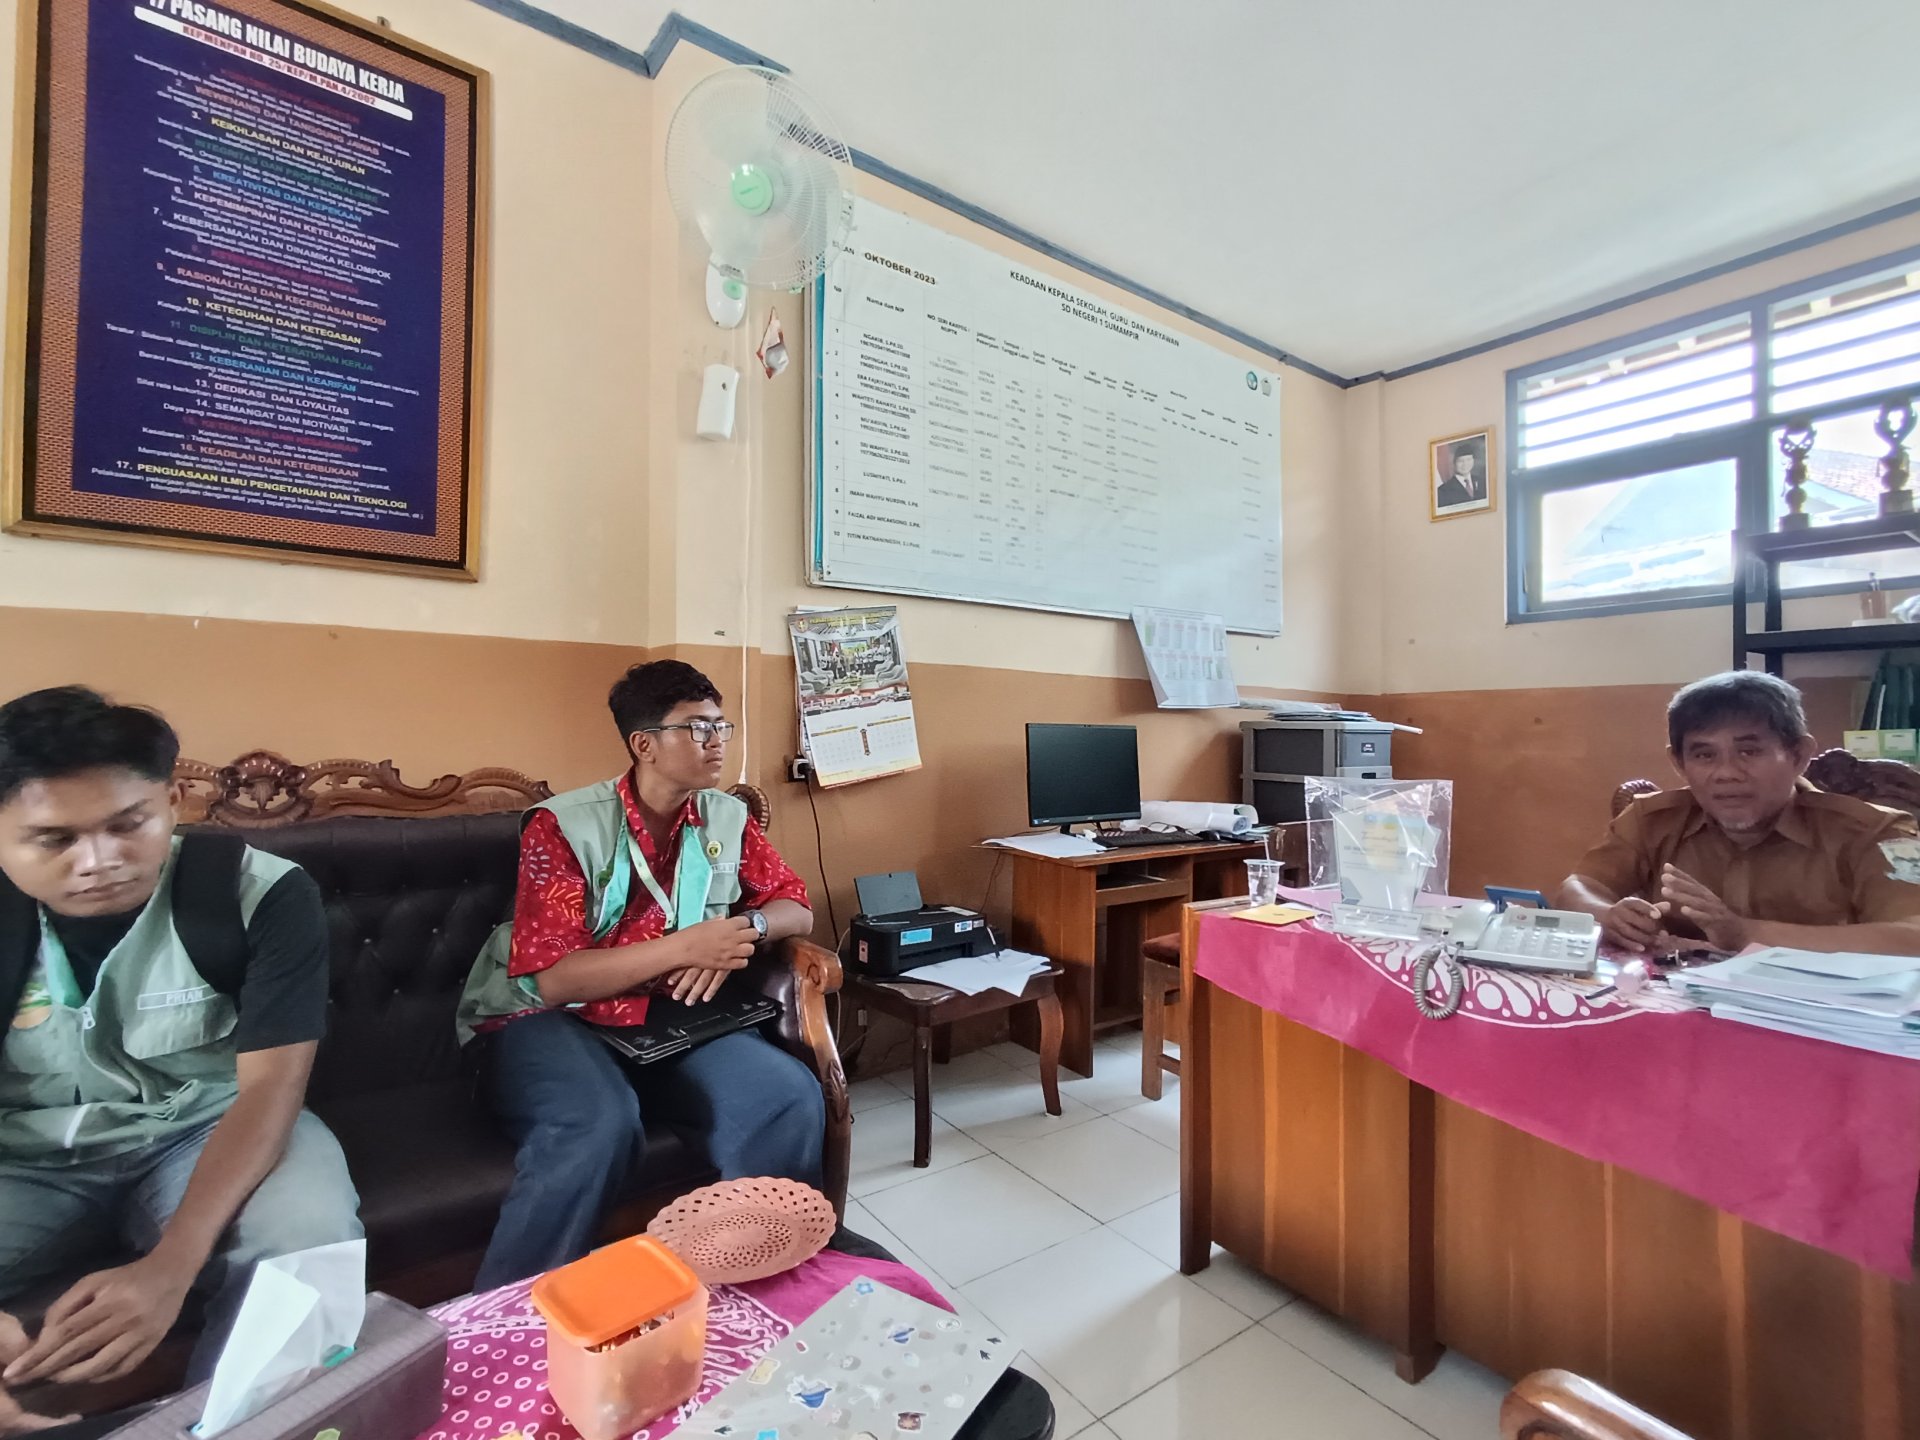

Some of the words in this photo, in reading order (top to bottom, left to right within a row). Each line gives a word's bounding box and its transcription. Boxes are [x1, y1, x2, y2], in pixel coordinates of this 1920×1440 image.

[170, 0, 242, 40] PASANG
[246, 23, 290, 59] NILAI
[294, 42, 356, 84] BUDAYA
[359, 68, 405, 103] KERJA
[262, 108, 285, 124] DAN
[191, 109, 201, 120] 3.
[210, 116, 280, 147] KEIKHLASAN
[282, 140, 304, 155] DAN
[306, 148, 365, 176] KEJUJURAN
[259, 158, 283, 174] DAN
[193, 190, 276, 223] KEPEMIMPINAN
[279, 215, 301, 229] DAN
[303, 223, 376, 251] KETELADANAN
[212, 169, 281, 198] KREATIVITAS
[283, 191, 305, 205] DAN
[307, 199, 361, 223] KEPEKAAN
[172, 211, 259, 243] KEBERSAMAAN
[260, 236, 283, 250] DAN
[285, 243, 335, 264] DINAMIKA
[337, 257, 391, 280] KELOMPOK
[864, 252, 911, 276] OKTOBER
[914, 271, 936, 285] 2023
[176, 266, 257, 294] RASIONALITAS
[259, 287, 282, 301] DAN
[285, 293, 354, 318] KECERDASAN
[355, 311, 386, 326] EMOSI
[186, 295, 202, 307] 10.
[205, 300, 273, 324] KETEGUHAN
[275, 317, 298, 329] DAN
[300, 323, 361, 344] KETEGASAN
[1010, 270, 1046, 292] KEADAAN
[1048, 286, 1075, 303] KEPALA
[1131, 320, 1145, 332] DAN
[1146, 327, 1180, 347] KARYAWAN
[1061, 303, 1071, 313] SD
[1072, 308, 1098, 324] NEGERI
[1099, 318, 1103, 326] 1
[1104, 320, 1140, 341] SUMAMPIR
[188, 349, 204, 361] 12.
[208, 354, 279, 376] KEBERANIAN
[282, 369, 304, 381] DAN
[306, 374, 356, 392] KEARIFAN
[189, 323, 236, 341] DISIPLIN
[238, 334, 261, 347] DAN
[341, 357, 373, 372] KERJA
[194, 377, 210, 388] 13.
[214, 381, 265, 399] DEDIKASI
[270, 392, 293, 404] DAN
[295, 397, 349, 415] LOYALITAS
[195, 397, 211, 408] 14.
[214, 401, 275, 420] SEMANGAT
[277, 413, 299, 424] DAN
[301, 417, 348, 433] MOTIVASI
[115, 459, 132, 470] 17.
[137, 462, 218, 482] PENGUASAAN
[220, 475, 247, 486] ILMU
[249, 479, 327, 497] PENGETAHUAN
[329, 491, 350, 501] DAN
[352, 494, 407, 509] TEKNOLOGI
[199, 445, 255, 461] KEADILAN
[258, 454, 281, 465] DAN
[283, 458, 358, 478] KETERBUKAAN
